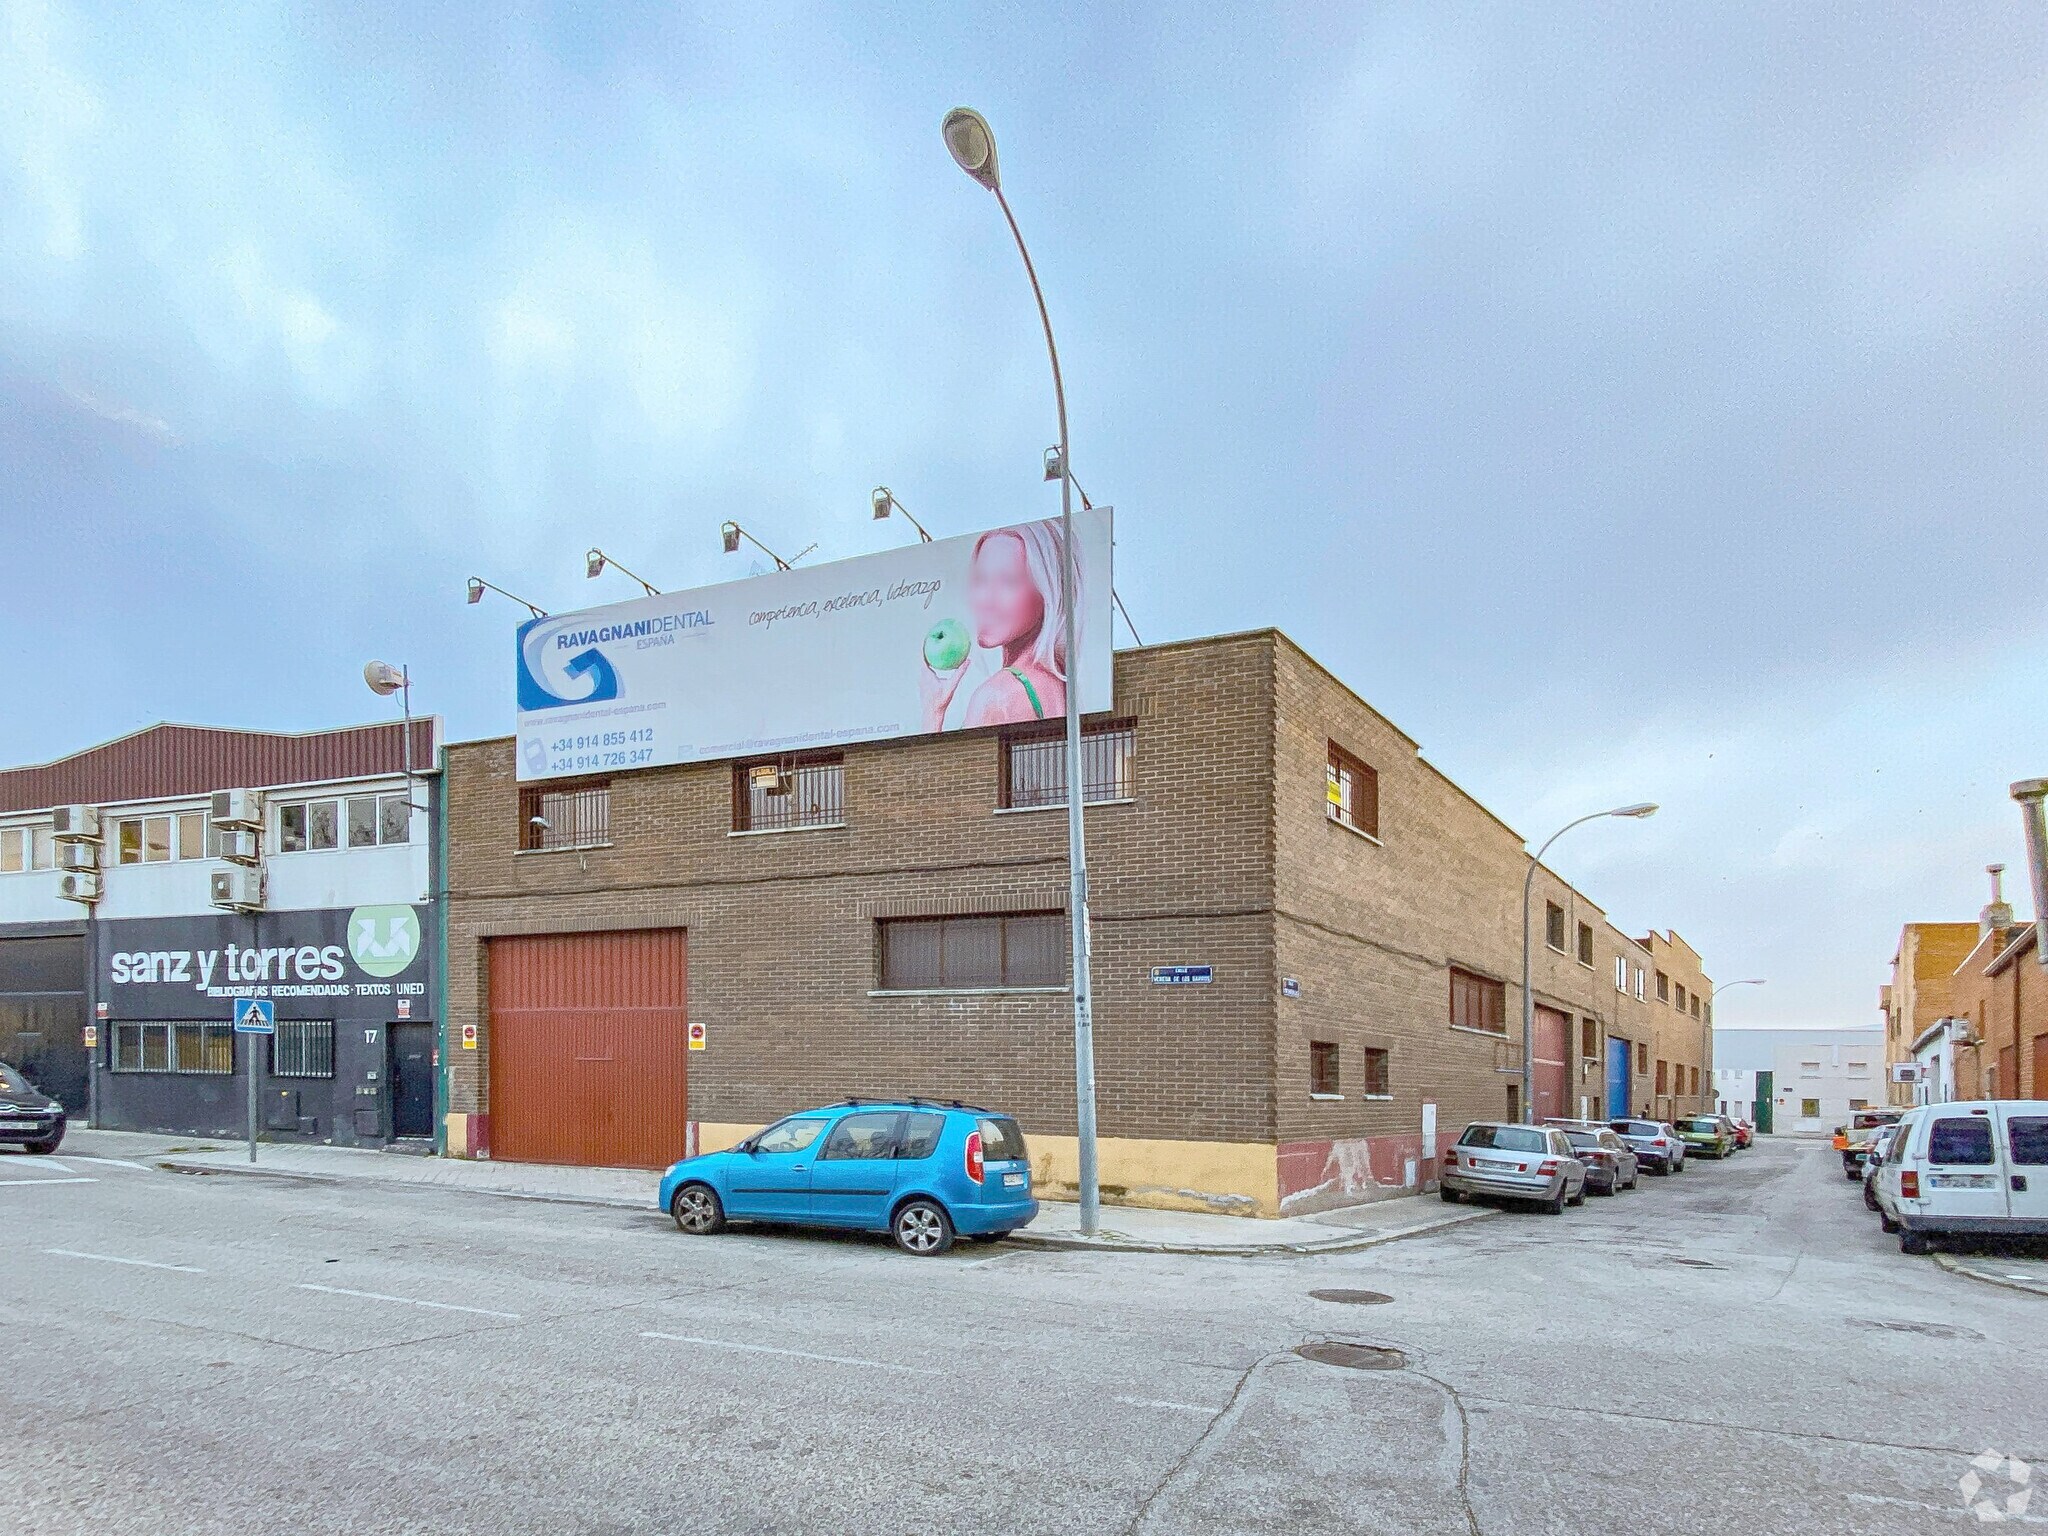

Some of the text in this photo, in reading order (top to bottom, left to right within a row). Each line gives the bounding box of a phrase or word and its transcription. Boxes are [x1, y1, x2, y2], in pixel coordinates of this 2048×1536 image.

[886, 578, 941, 610] liderazgo
[636, 634, 675, 650] ESPAÑA
[551, 728, 653, 752] +34 914 855 412
[551, 748, 653, 772] +34 914 726 347
[111, 943, 345, 991] sanz y torres
[271, 984, 349, 997] RECOMENDADAS
[355, 983, 391, 996] TEXTOS
[396, 982, 425, 995] UNED
[364, 1029, 378, 1044] 17
